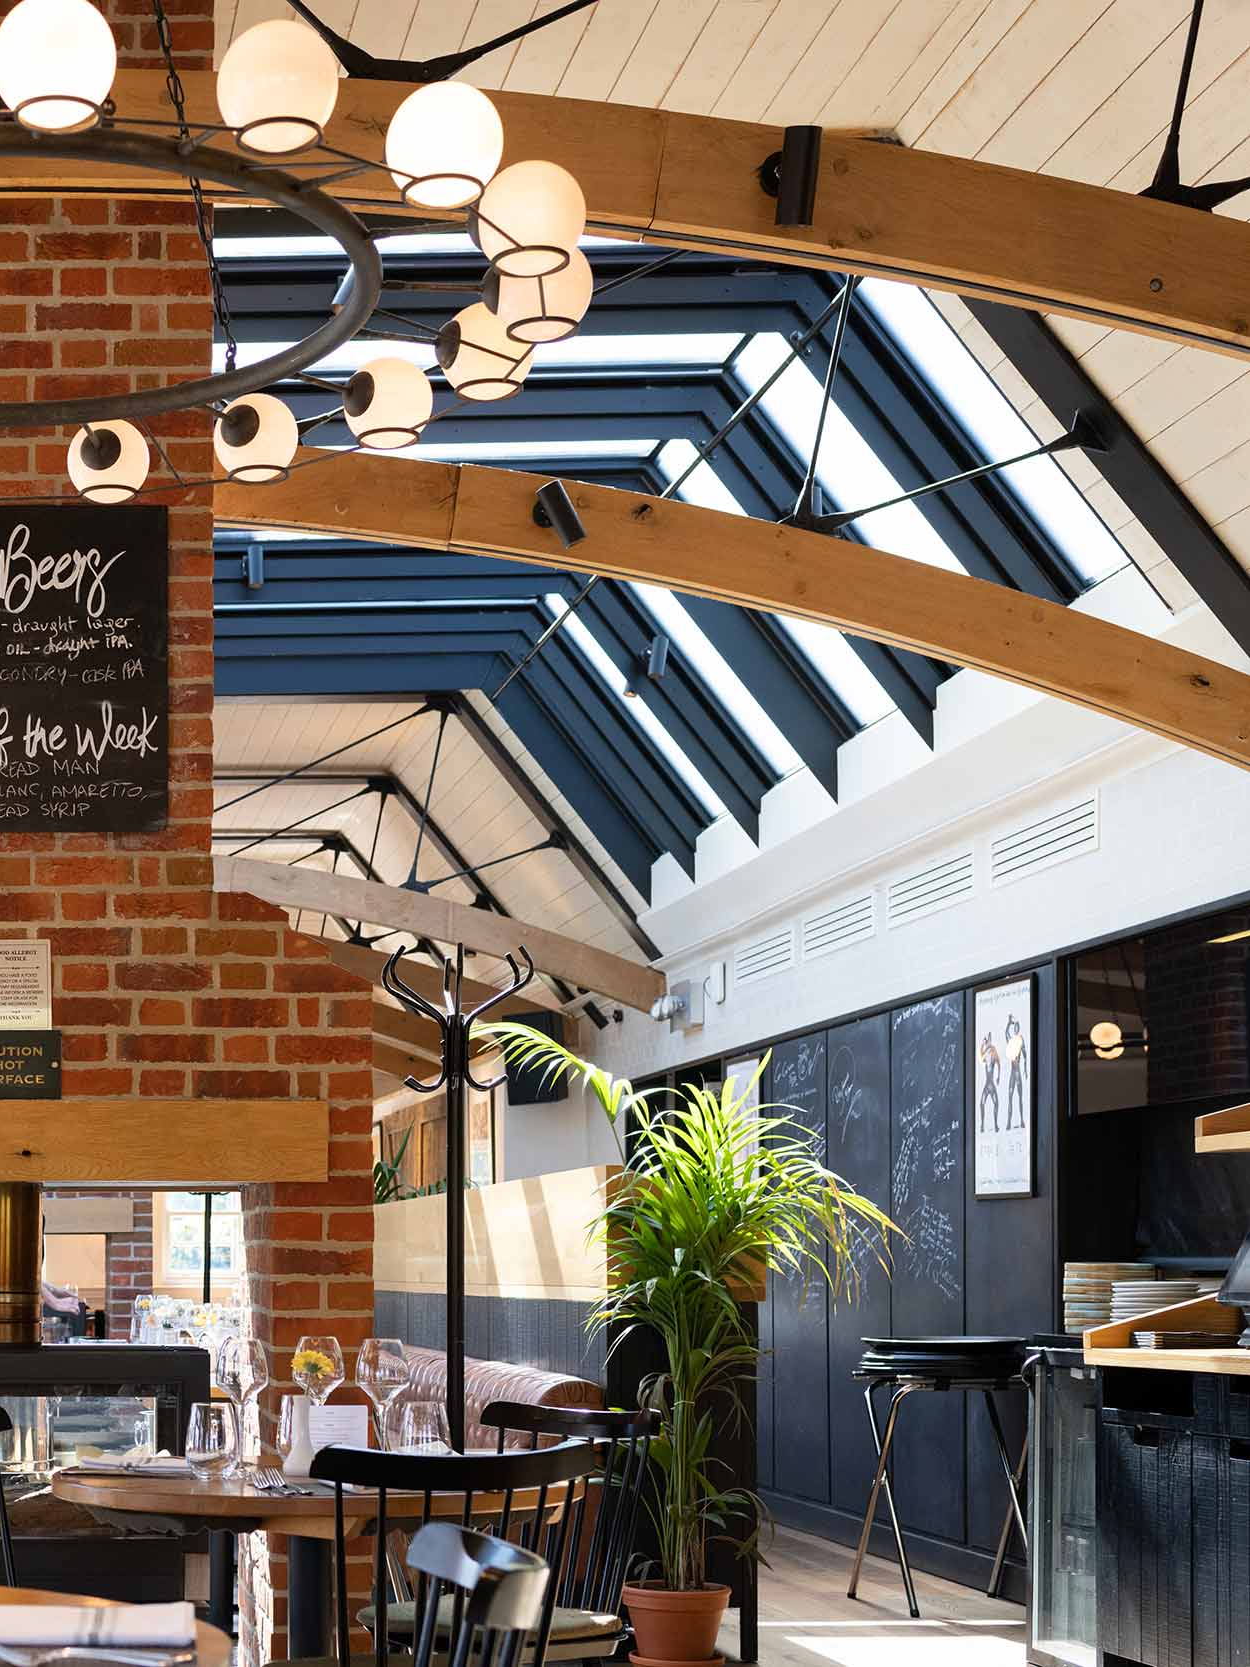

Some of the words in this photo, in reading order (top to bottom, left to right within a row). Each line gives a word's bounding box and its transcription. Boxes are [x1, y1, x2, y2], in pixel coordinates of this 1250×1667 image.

[122, 657, 145, 680] IPA
[22, 712, 67, 758] the
[75, 699, 159, 761] Week
[53, 758, 99, 777] MAN
